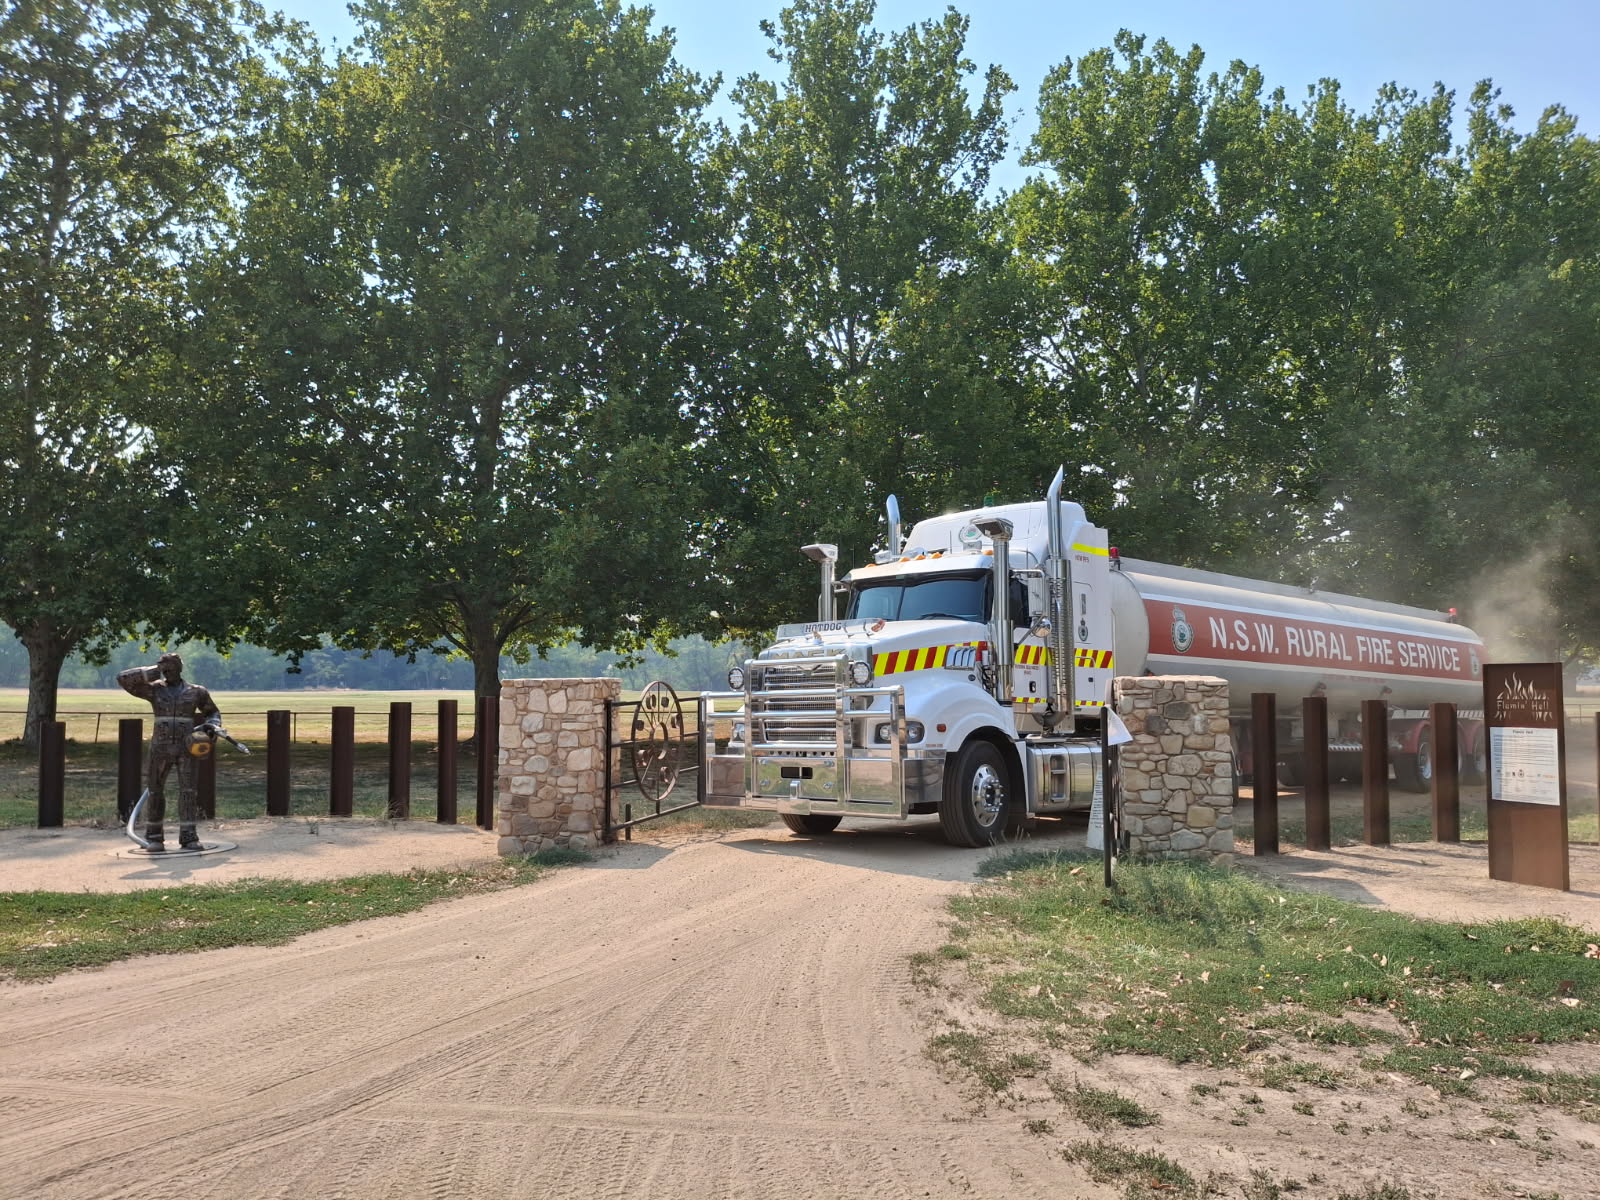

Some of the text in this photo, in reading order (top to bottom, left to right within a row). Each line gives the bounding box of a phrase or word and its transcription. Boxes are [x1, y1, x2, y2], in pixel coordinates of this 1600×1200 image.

[805, 623, 841, 632] HOTDOG
[1209, 616, 1460, 672] N.S.W. RURAL FIRE SERVICE
[1532, 701, 1549, 711] Hell
